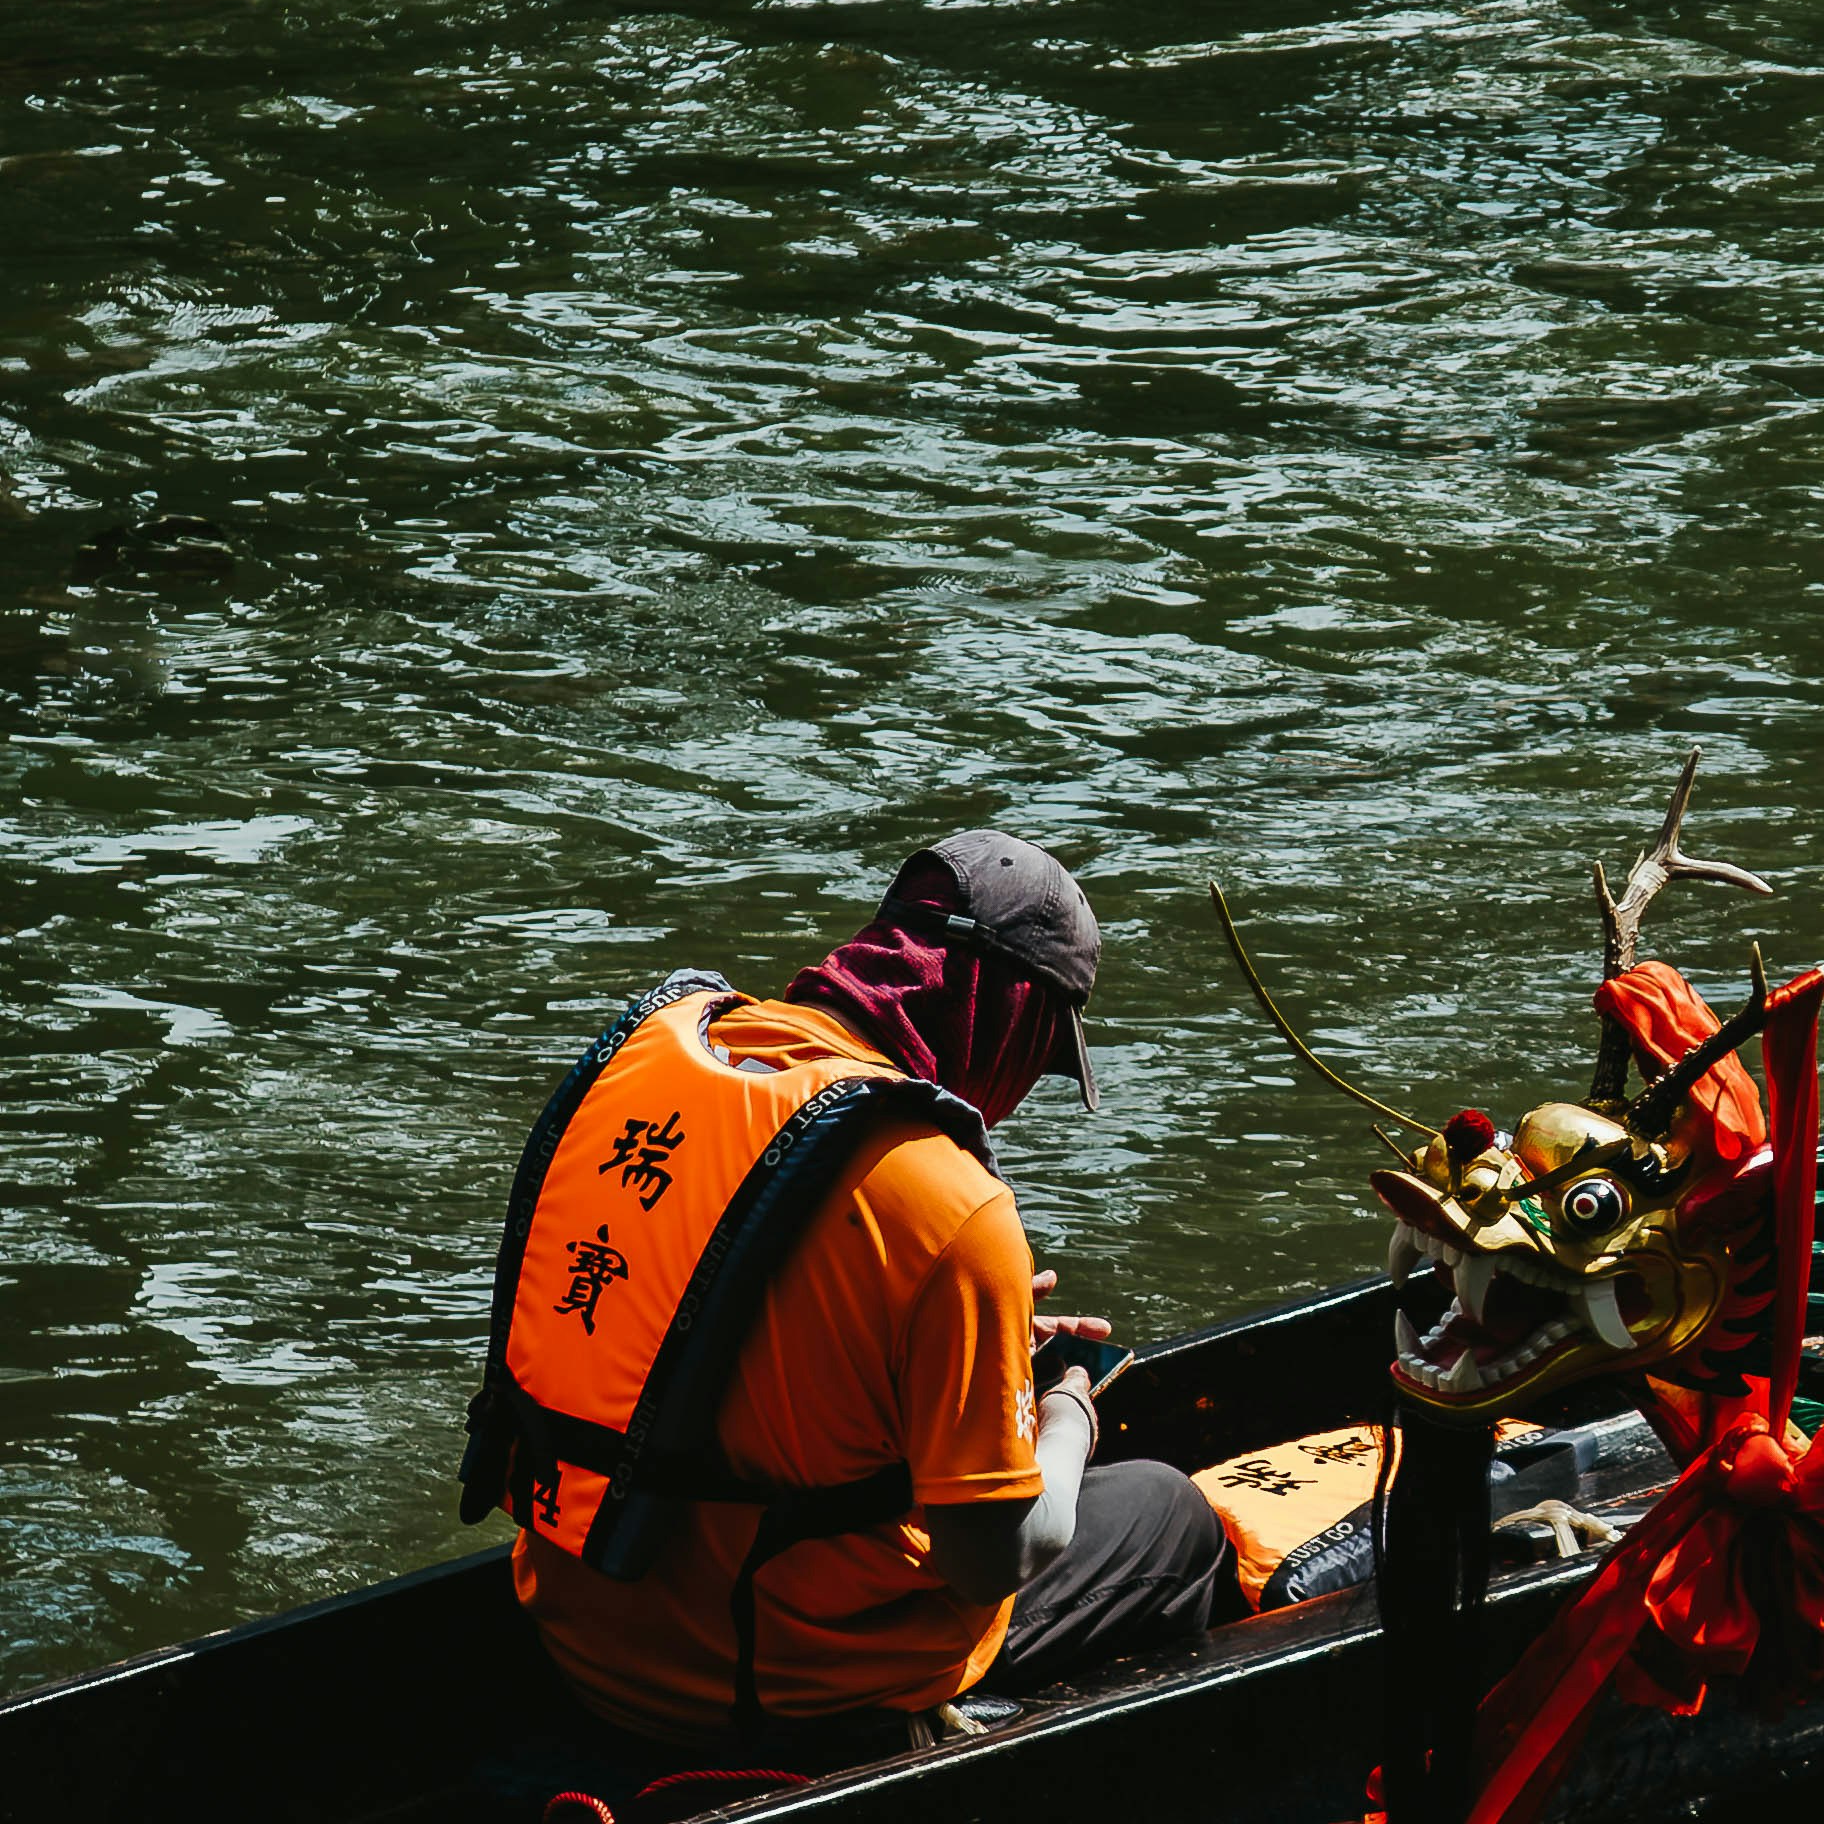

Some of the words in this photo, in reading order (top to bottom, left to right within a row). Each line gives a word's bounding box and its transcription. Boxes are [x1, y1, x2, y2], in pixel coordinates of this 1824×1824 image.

[627, 988, 682, 1027] JUST
[794, 1080, 848, 1130] JUST
[553, 1110, 686, 1337] 瑞寶
[1286, 1536, 1330, 1568] JUST
